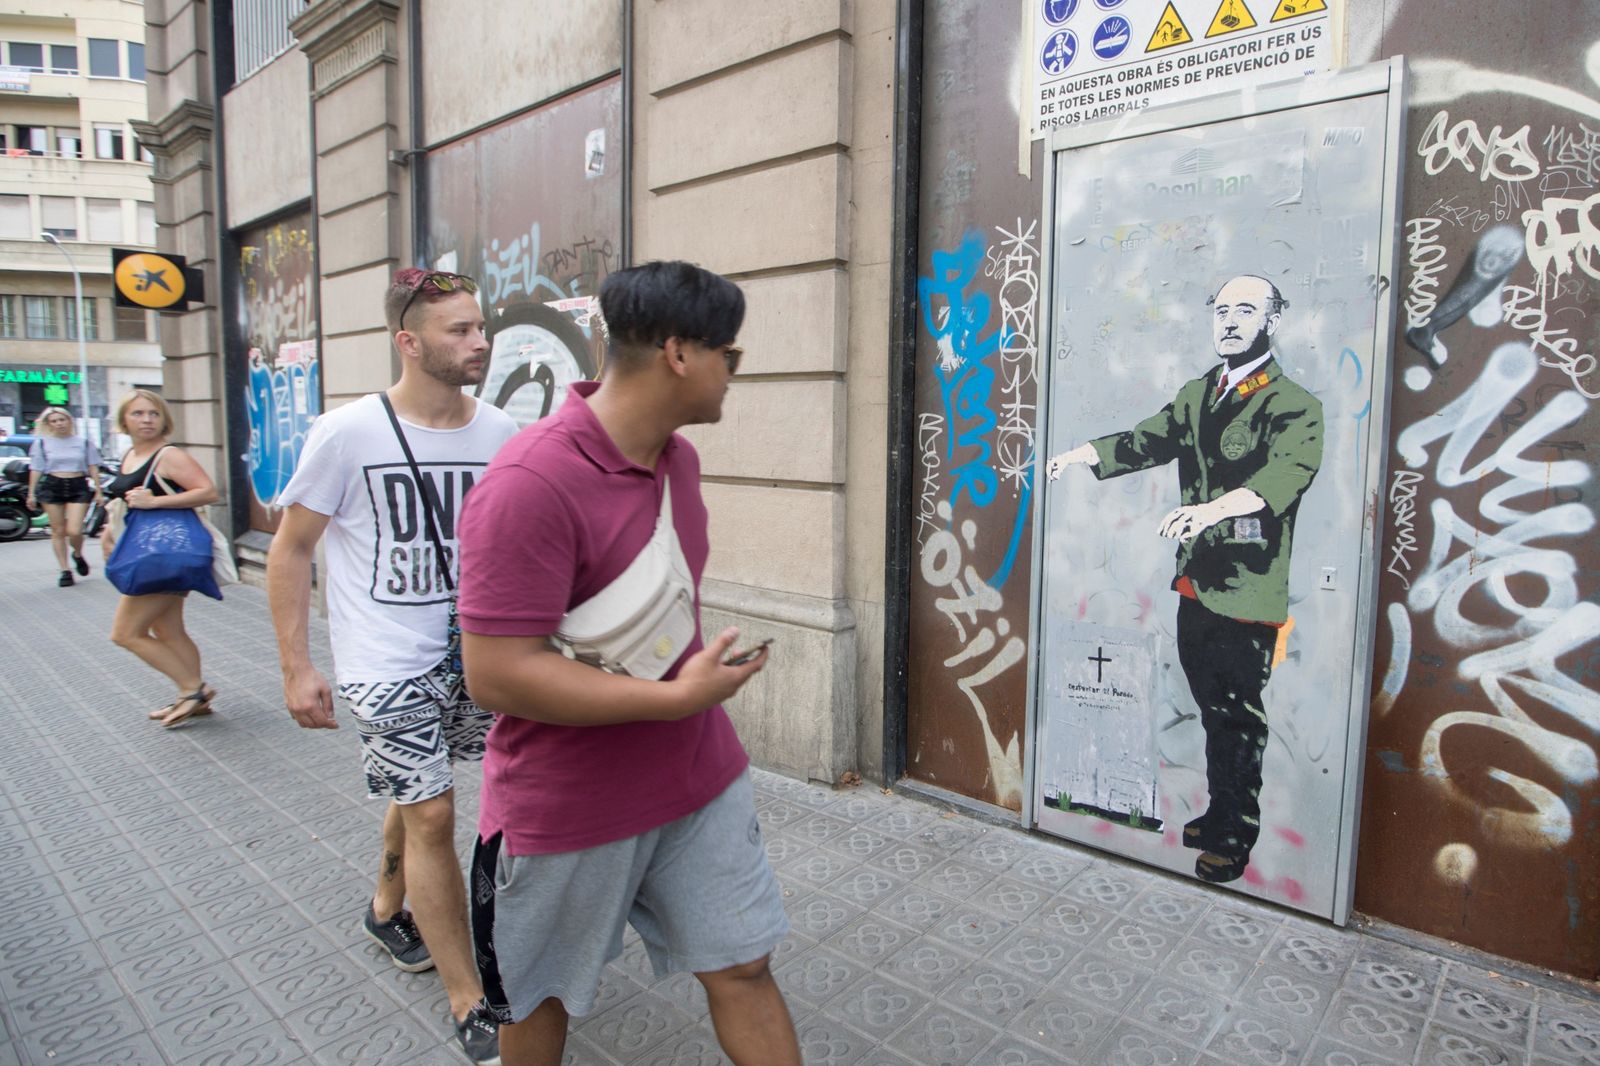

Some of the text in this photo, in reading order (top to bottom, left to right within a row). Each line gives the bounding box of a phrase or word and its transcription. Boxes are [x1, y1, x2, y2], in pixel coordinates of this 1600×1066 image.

[1041, 26, 1322, 100] EN AQUESTA OBRA ÉS OBLIGATORI FER ÚS
[1041, 45, 1315, 115] DE TOTES LES NORMES DE PREVENCIÓ DE
[1040, 98, 1149, 130] RISCOS LABORALS
[387, 545, 460, 595] SUR
